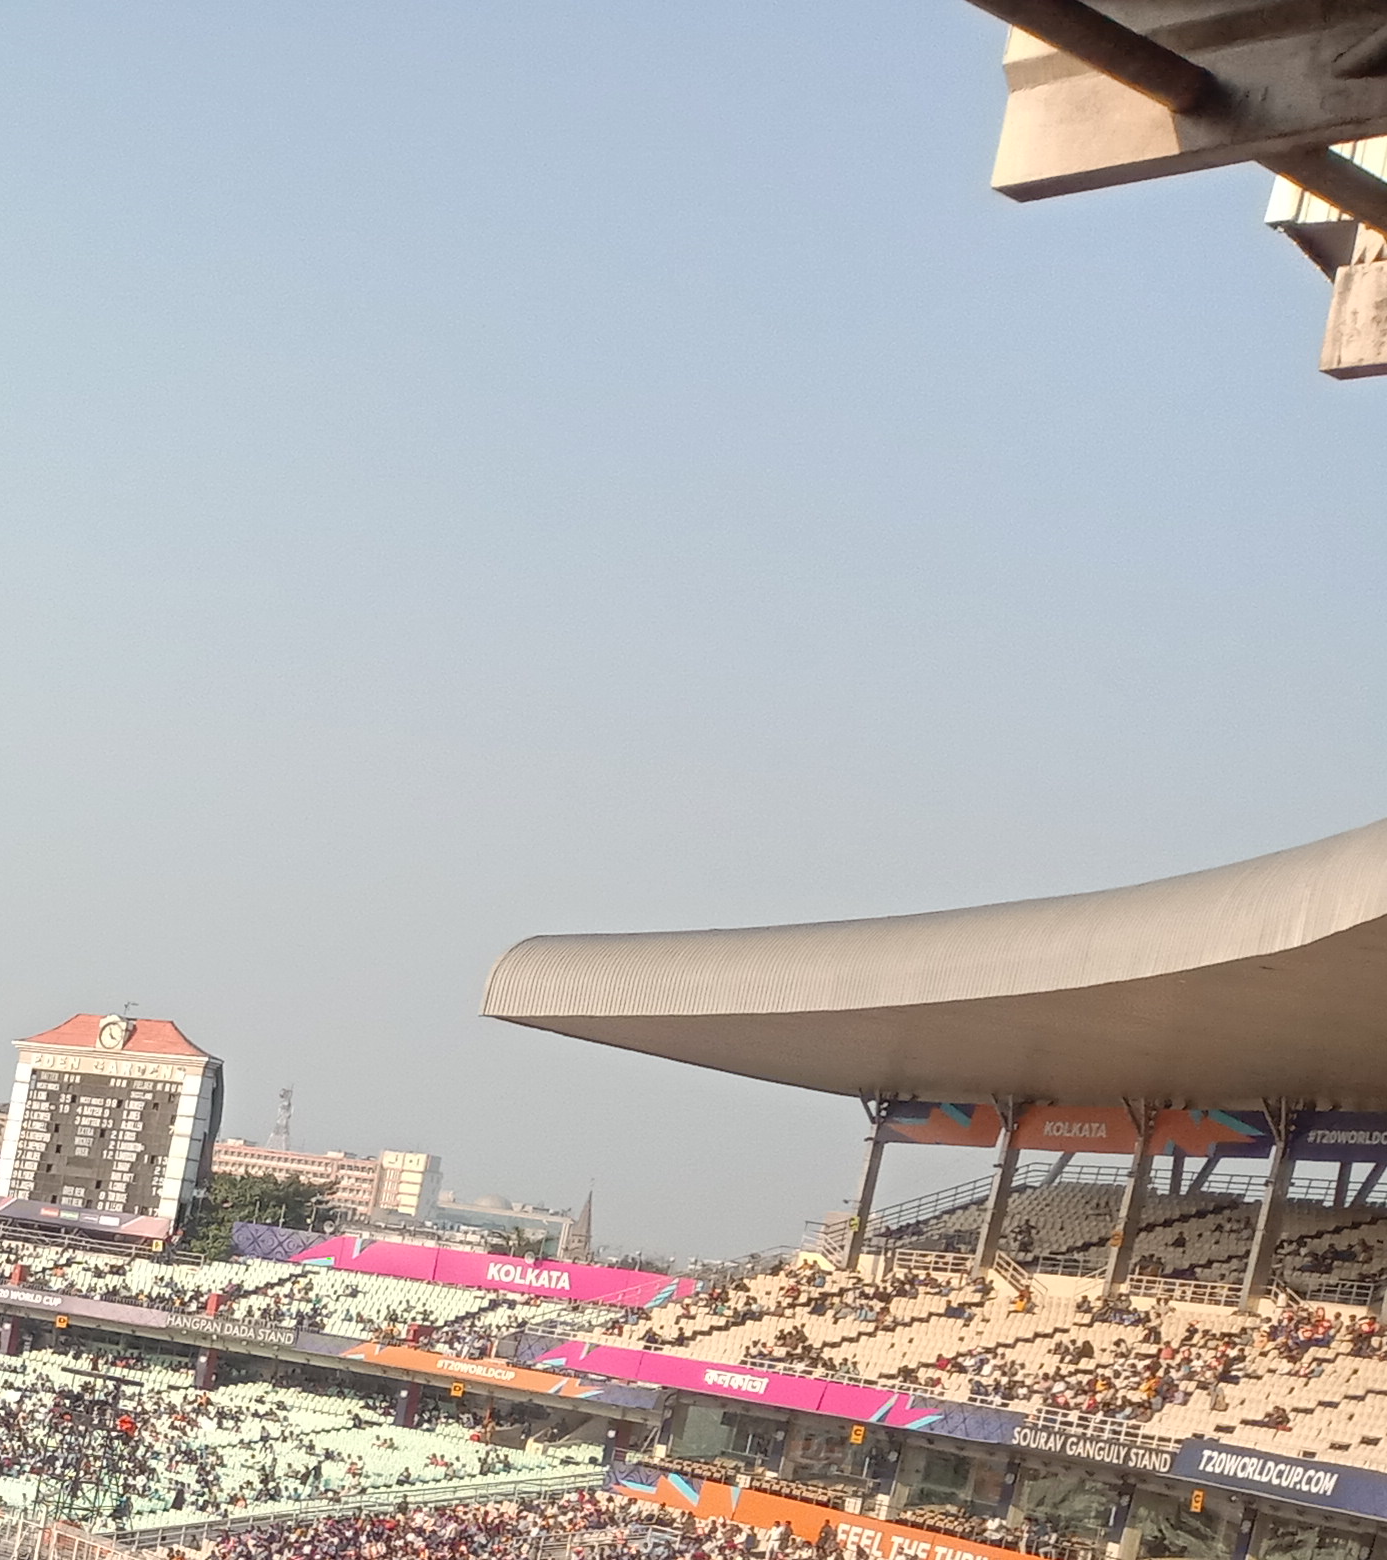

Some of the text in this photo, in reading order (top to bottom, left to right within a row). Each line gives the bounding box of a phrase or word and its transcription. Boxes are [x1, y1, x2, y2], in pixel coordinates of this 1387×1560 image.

[76, 1106, 83, 1115] 4
[74, 1115, 81, 1125] 3
[101, 1118, 113, 1128] 33
[1044, 1120, 1107, 1139] KOLKATA
[110, 1130, 117, 1139] 2
[103, 1150, 113, 1159] 12
[108, 1141, 116, 1150] 2
[487, 1263, 570, 1290] KOLKATA
[10, 1290, 42, 1305] WORLD
[43, 1295, 62, 1307] CUP
[166, 1314, 294, 1345] HANGPAN DADA STAND
[436, 1359, 516, 1381] #T20WORLDCUP
[705, 1369, 769, 1394] কলকাতা
[854, 1428, 863, 1437] C
[1012, 1426, 1171, 1473] SOURAV GANGULY STAND
[1198, 1449, 1339, 1496] T20WORLDCUP.COM
[1193, 1494, 1202, 1504] C
[837, 1523, 883, 1558] FEEL
